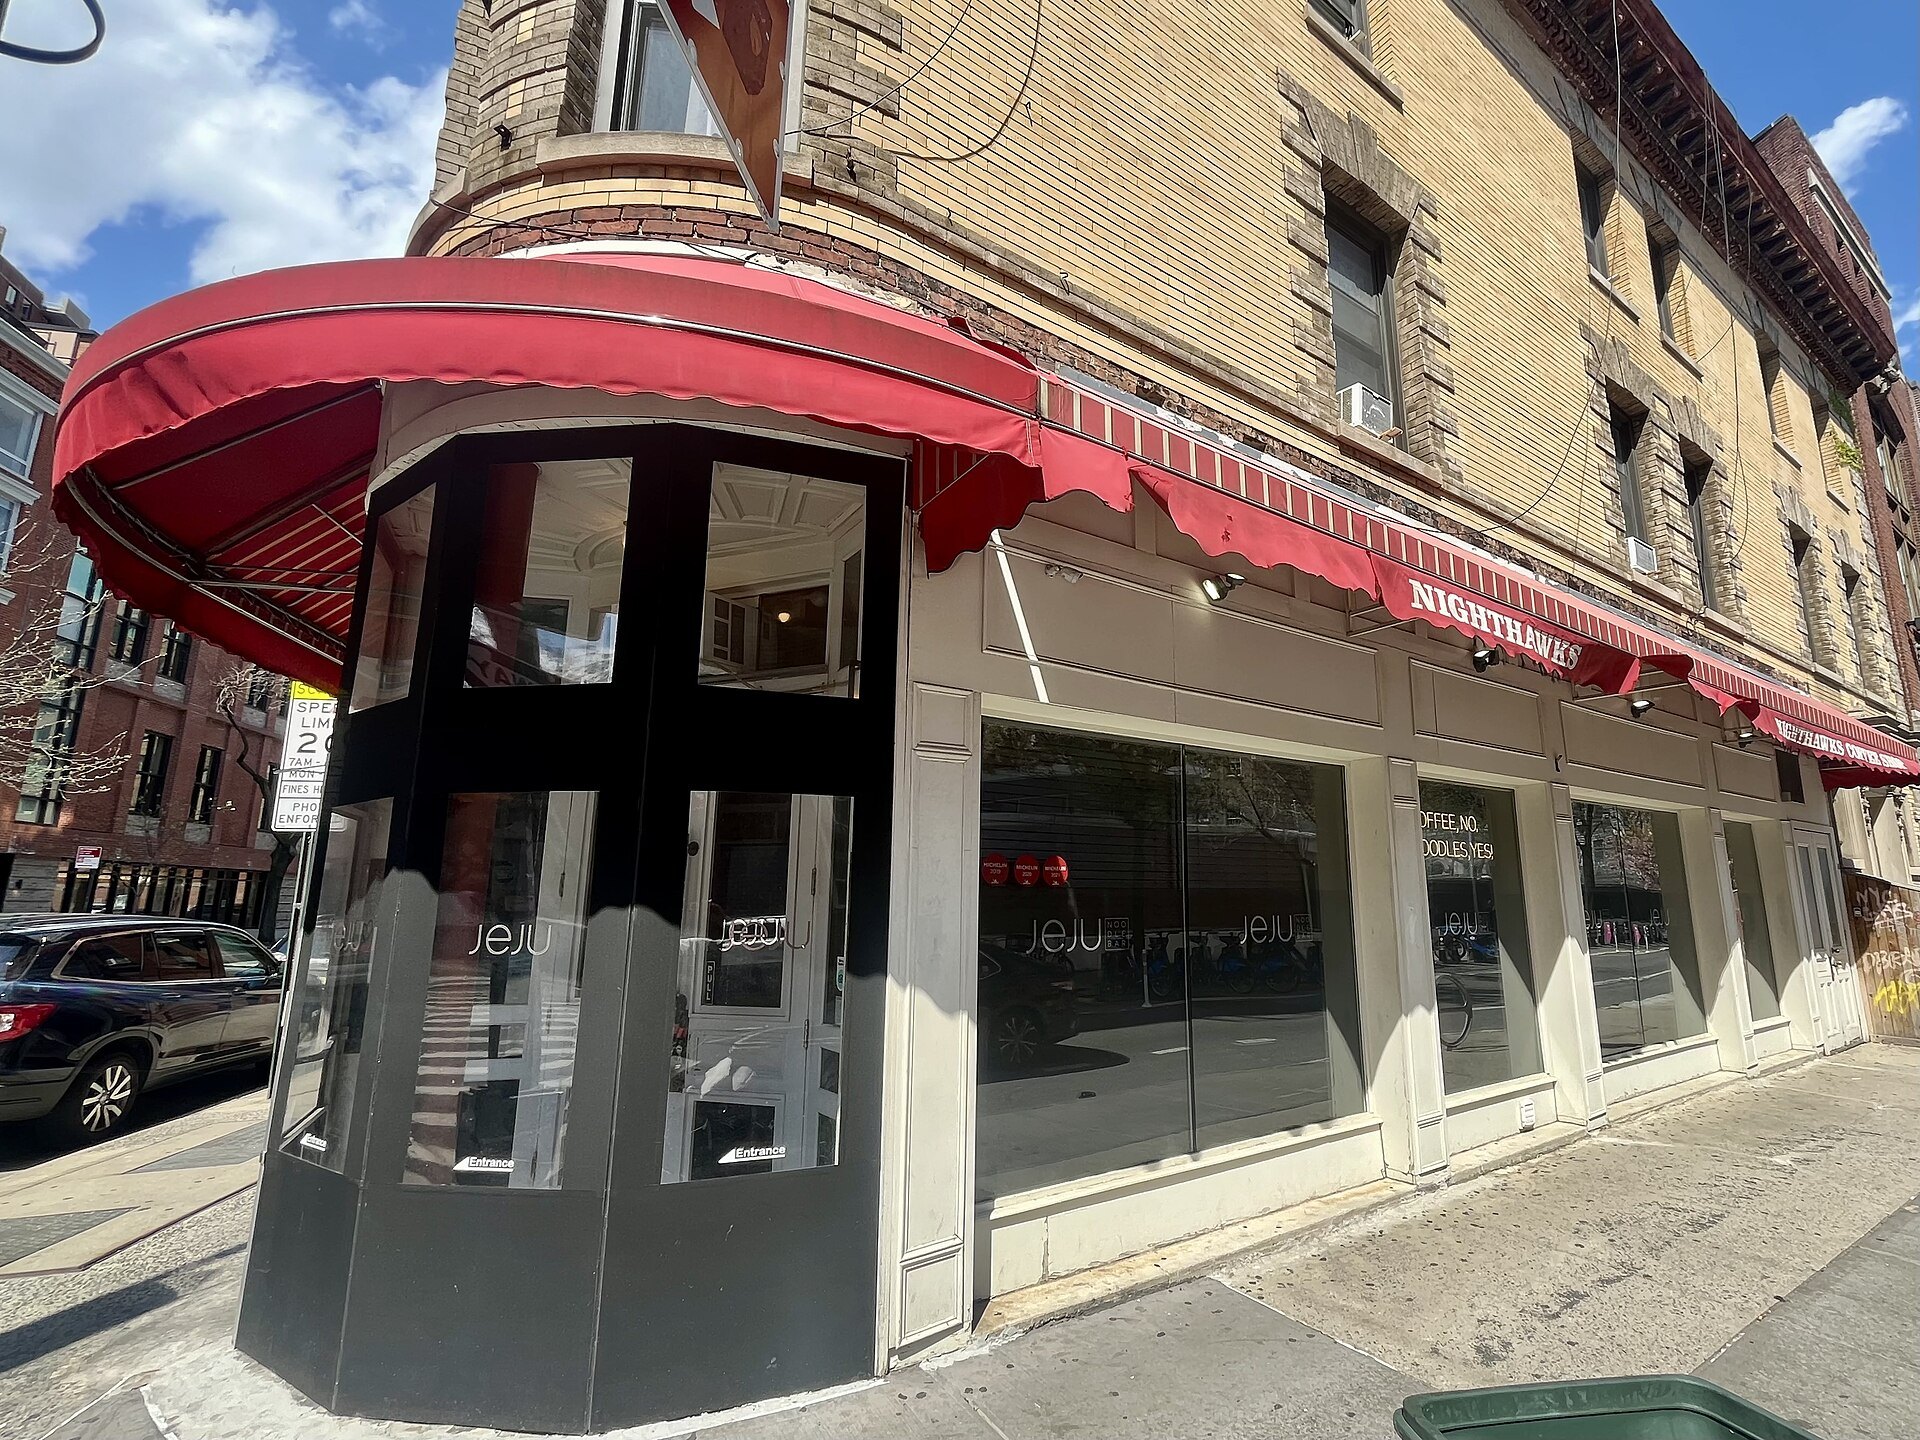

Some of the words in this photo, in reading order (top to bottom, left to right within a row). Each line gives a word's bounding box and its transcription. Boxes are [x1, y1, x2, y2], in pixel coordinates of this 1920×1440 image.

[1408, 578, 1583, 670] NIGHTHAWKS
[1774, 718, 1845, 756] NIGHTHAWKS
[282, 784, 308, 794] FINES
[706, 965, 714, 1001] PULL
[469, 1156, 514, 1168] Entrance
[736, 1146, 786, 1158] Entrance
